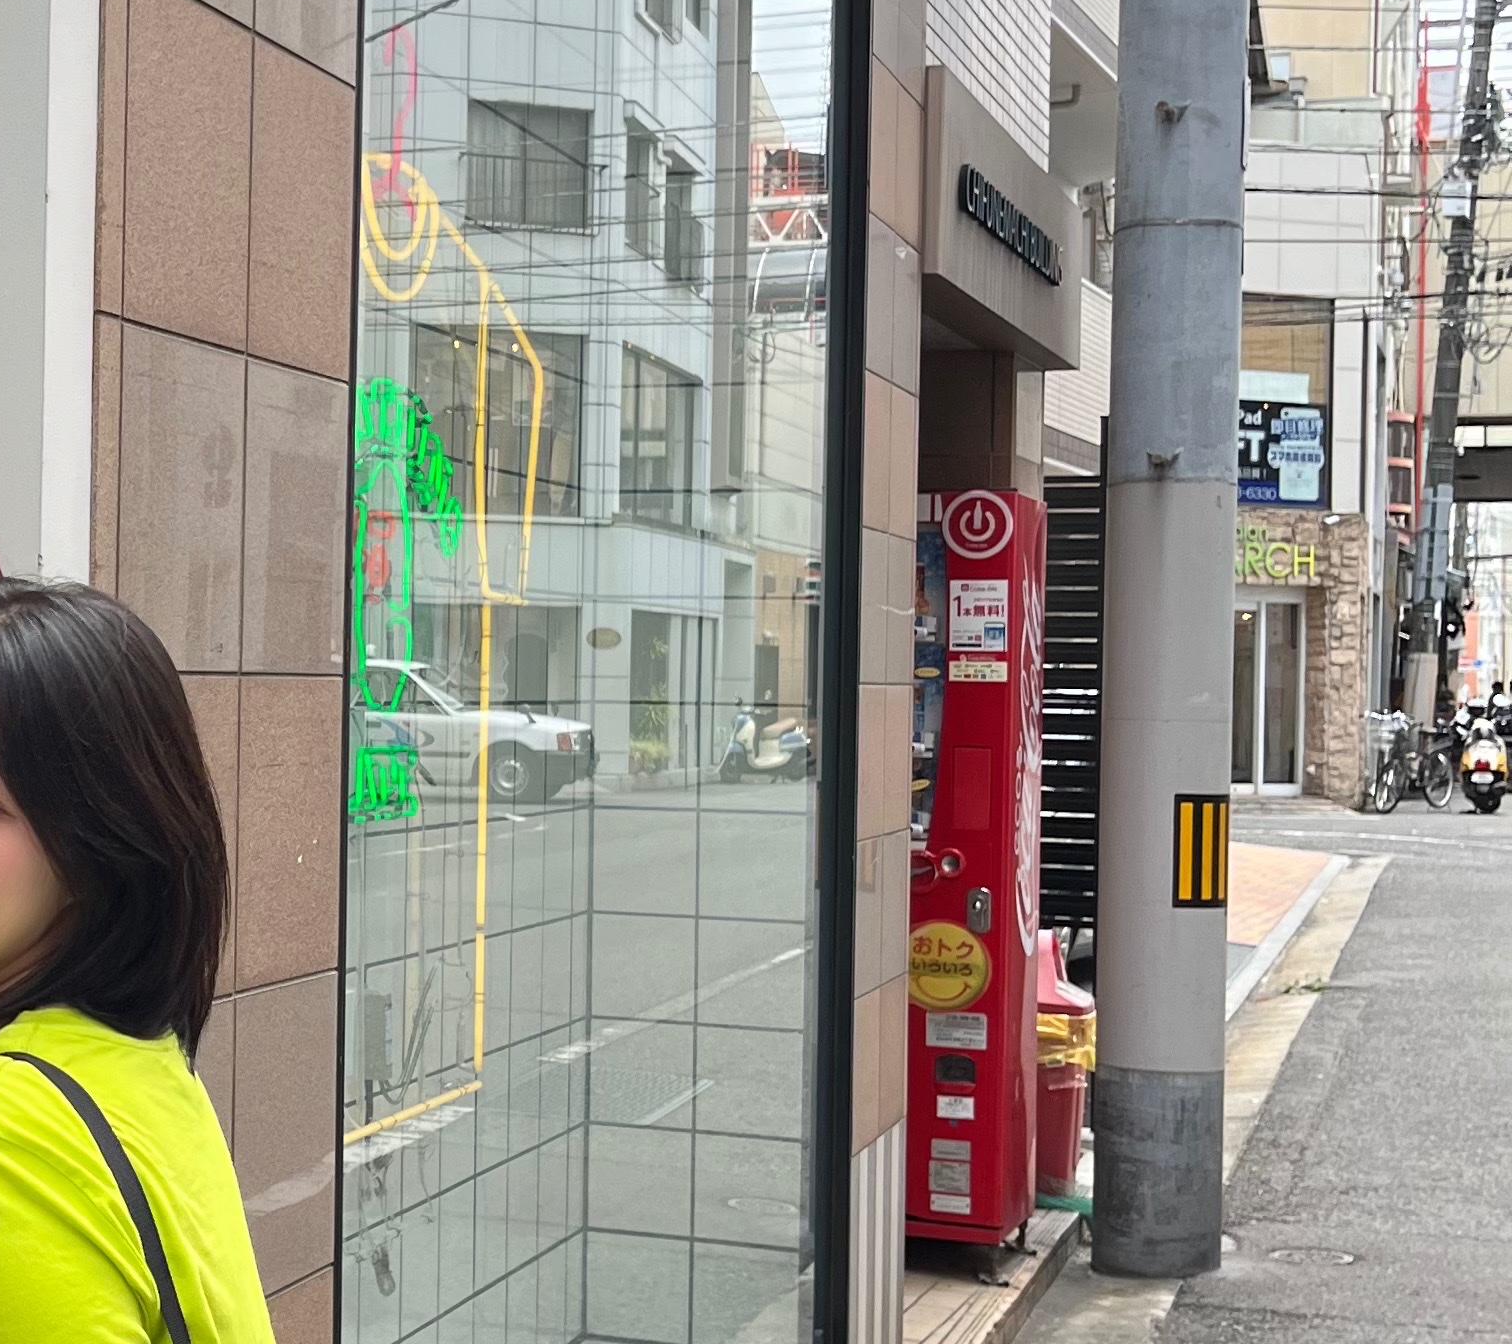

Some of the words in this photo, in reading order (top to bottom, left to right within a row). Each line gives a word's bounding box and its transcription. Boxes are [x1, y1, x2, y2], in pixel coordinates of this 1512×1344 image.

[912, 936, 974, 959] おトク
[912, 957, 973, 977] いろいろ
